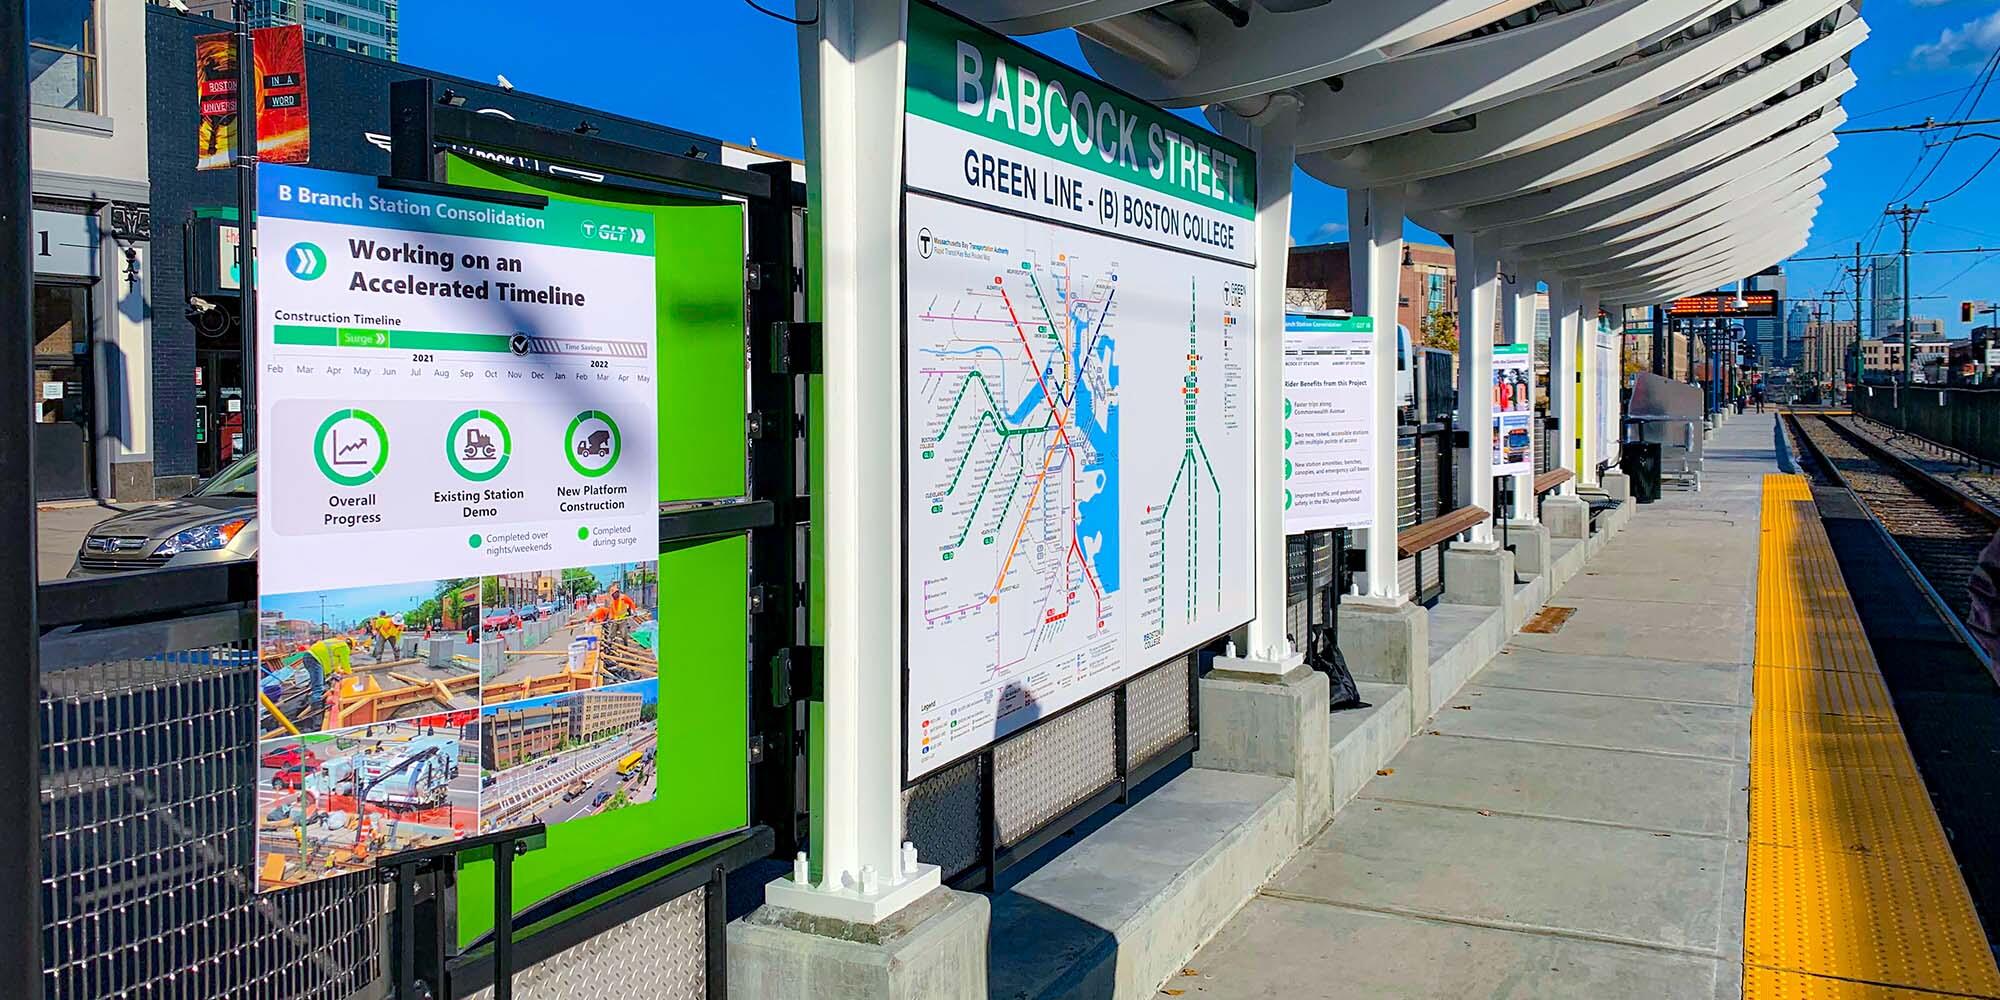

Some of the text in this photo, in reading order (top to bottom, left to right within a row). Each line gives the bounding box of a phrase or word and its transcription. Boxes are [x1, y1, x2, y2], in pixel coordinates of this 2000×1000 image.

[208, 80, 237, 92] BOSTON
[271, 75, 294, 86] IN A
[272, 96, 295, 106] WORD
[956, 39, 1238, 204] BABCOCK STREET
[964, 148, 1037, 201] GREEN
[1044, 171, 1083, 212] LINE
[1098, 187, 1119, 228] (B)
[1124, 194, 1179, 237] BOSTON
[1183, 212, 1235, 250] COLLEGE
[278, 184, 545, 230] B Branch Station Consolidation
[599, 224, 628, 242] GLT
[348, 238, 522, 273] Working on an
[348, 271, 586, 307] Accelerated Timeline
[274, 310, 402, 326] Construction Timeline
[344, 334, 372, 345] Surge
[565, 343, 603, 352] Time Savings
[412, 354, 434, 362] 2021
[267, 364, 284, 373] Feb
[296, 365, 314, 374] Mar
[326, 366, 342, 376] Apr
[353, 366, 372, 376] May
[410, 368, 422, 377] Jul
[434, 369, 450, 379] Aug
[460, 370, 474, 379] Sep
[485, 370, 498, 378] Oct
[531, 371, 545, 380] Dec
[554, 372, 566, 380] Jan
[576, 372, 588, 381] Feb
[597, 373, 610, 381] Mar
[618, 374, 630, 383] Apr
[637, 374, 651, 384] May
[1349, 380, 1367, 388] Project
[434, 488, 524, 506] Existing Station
[557, 484, 628, 498] New Platform
[329, 493, 376, 507] Overall
[559, 499, 625, 513] Construction
[324, 511, 382, 527] Progress
[463, 506, 497, 518] Demo
[486, 532, 549, 545] Completed over
[592, 525, 631, 538] Completed
[592, 535, 637, 548] during surge
[486, 542, 552, 556] nights/weekends
